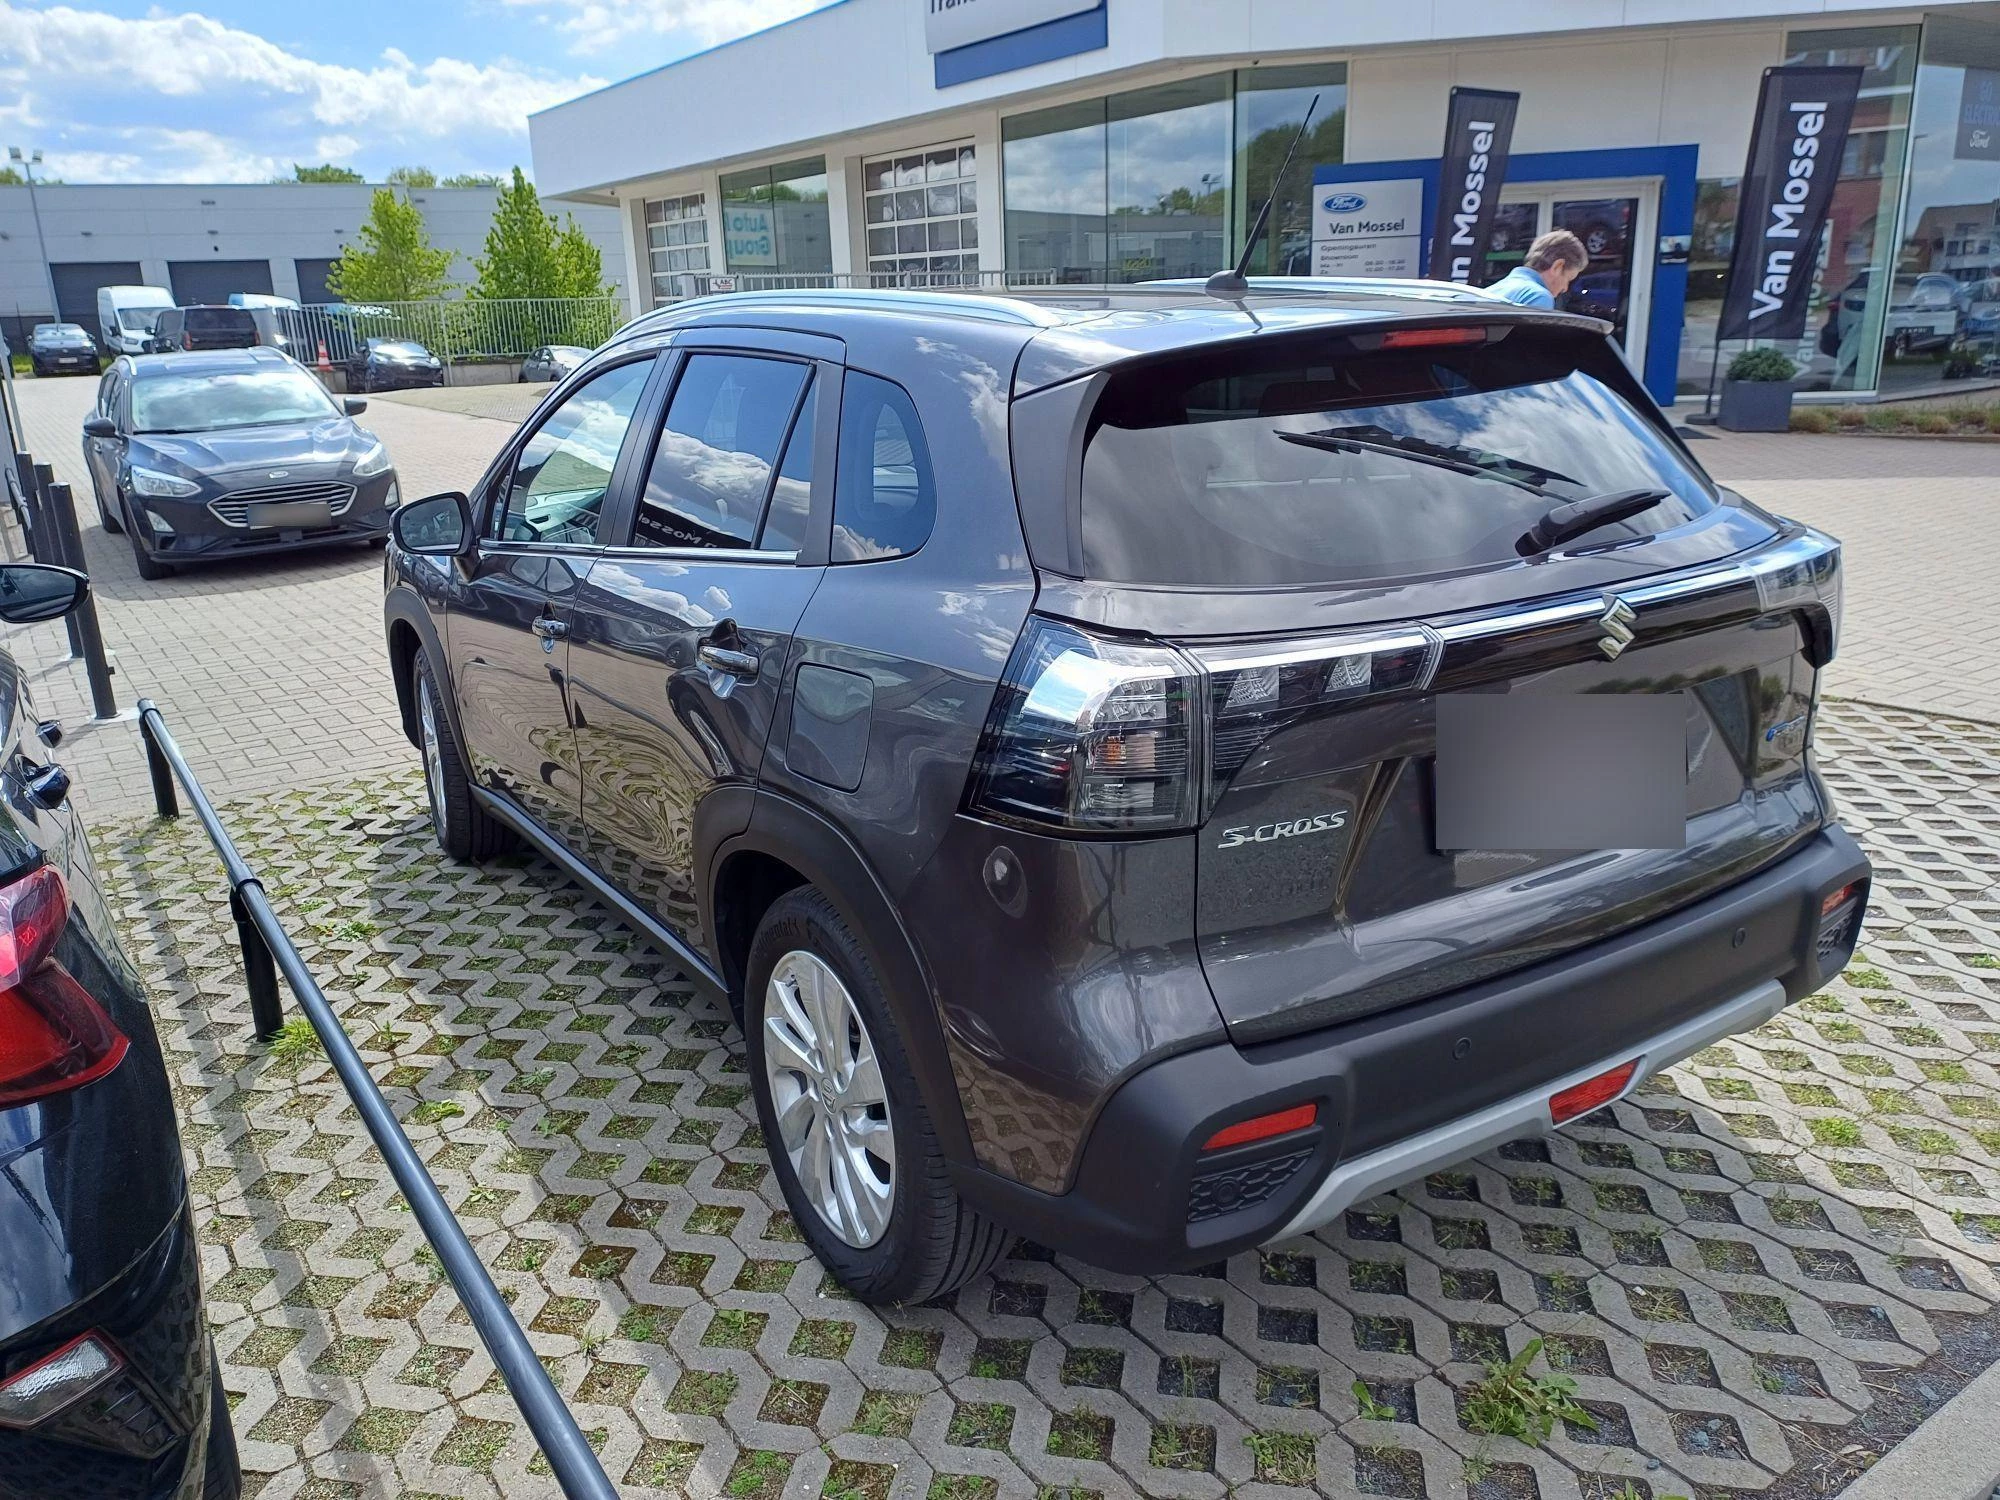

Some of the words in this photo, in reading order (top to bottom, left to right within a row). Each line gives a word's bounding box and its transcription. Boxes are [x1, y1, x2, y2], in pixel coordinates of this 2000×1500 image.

[1450, 120, 1496, 247] Mossel
[1765, 101, 1829, 239] Mossel
[1329, 222, 1354, 235] Van
[1358, 218, 1405, 233] Mossel
[1748, 249, 1796, 321] Van
[1217, 810, 1348, 849] S-CROSS
